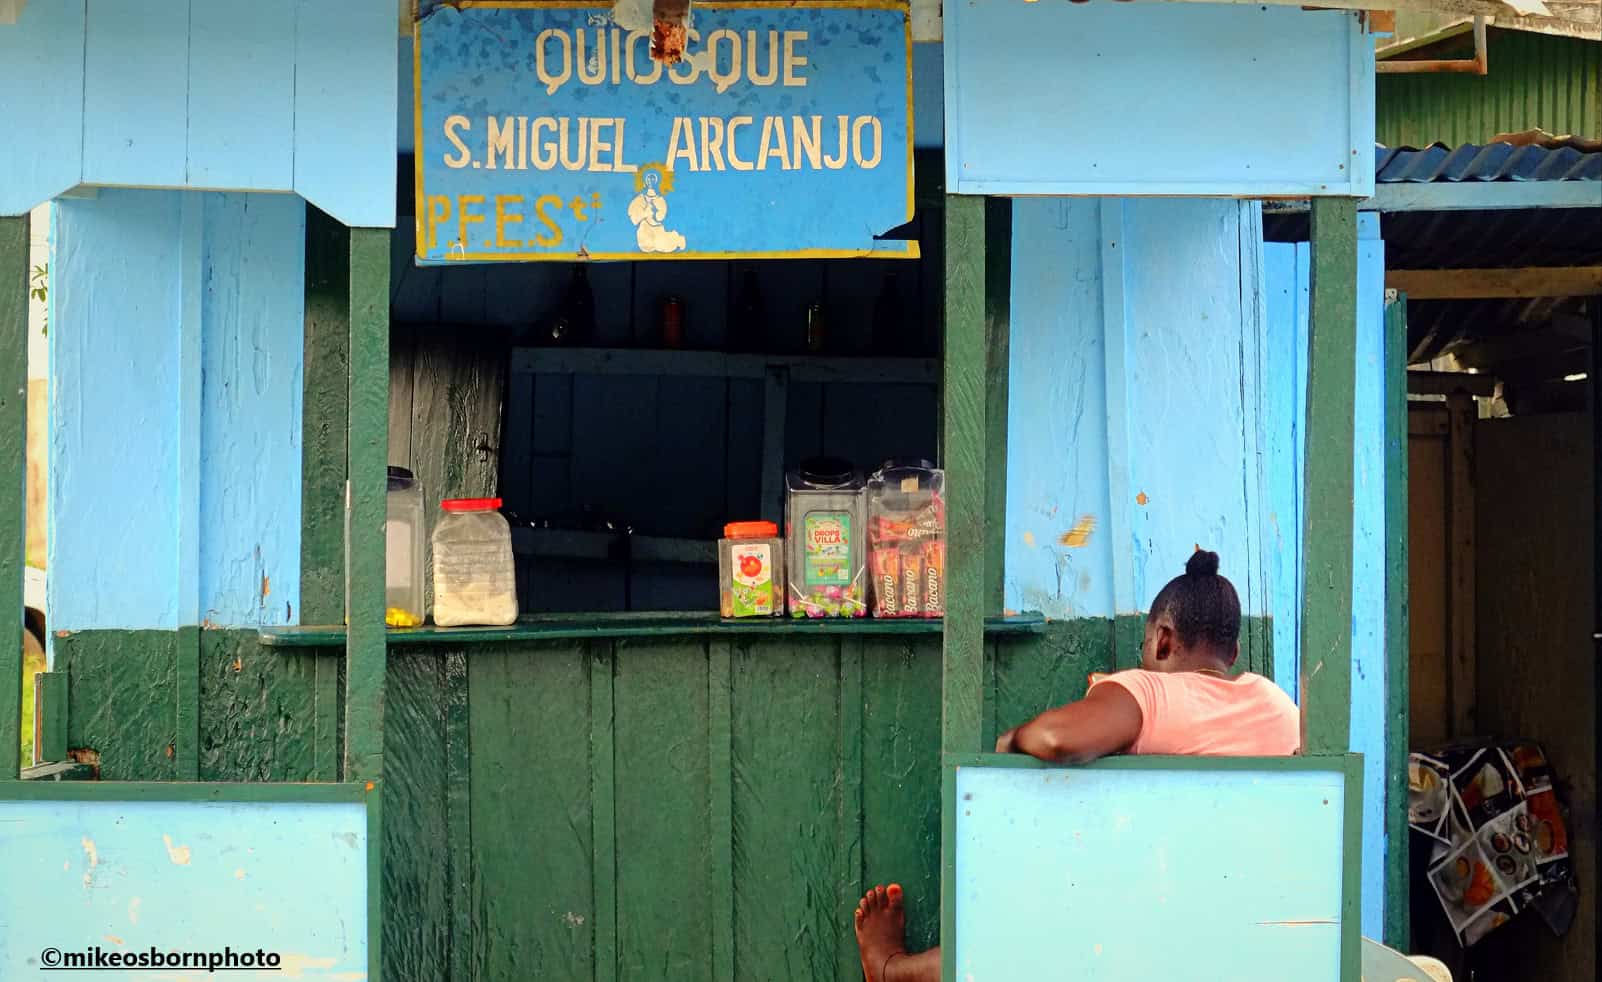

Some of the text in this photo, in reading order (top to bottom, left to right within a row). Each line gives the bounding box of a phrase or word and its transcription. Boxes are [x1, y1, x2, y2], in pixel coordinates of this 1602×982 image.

[665, 115, 882, 172] ARCANJO
[814, 529, 840, 537] DROPS
[814, 536, 841, 544] VILLA
[904, 570, 917, 613] Bacano
[925, 567, 939, 612] Bacano
